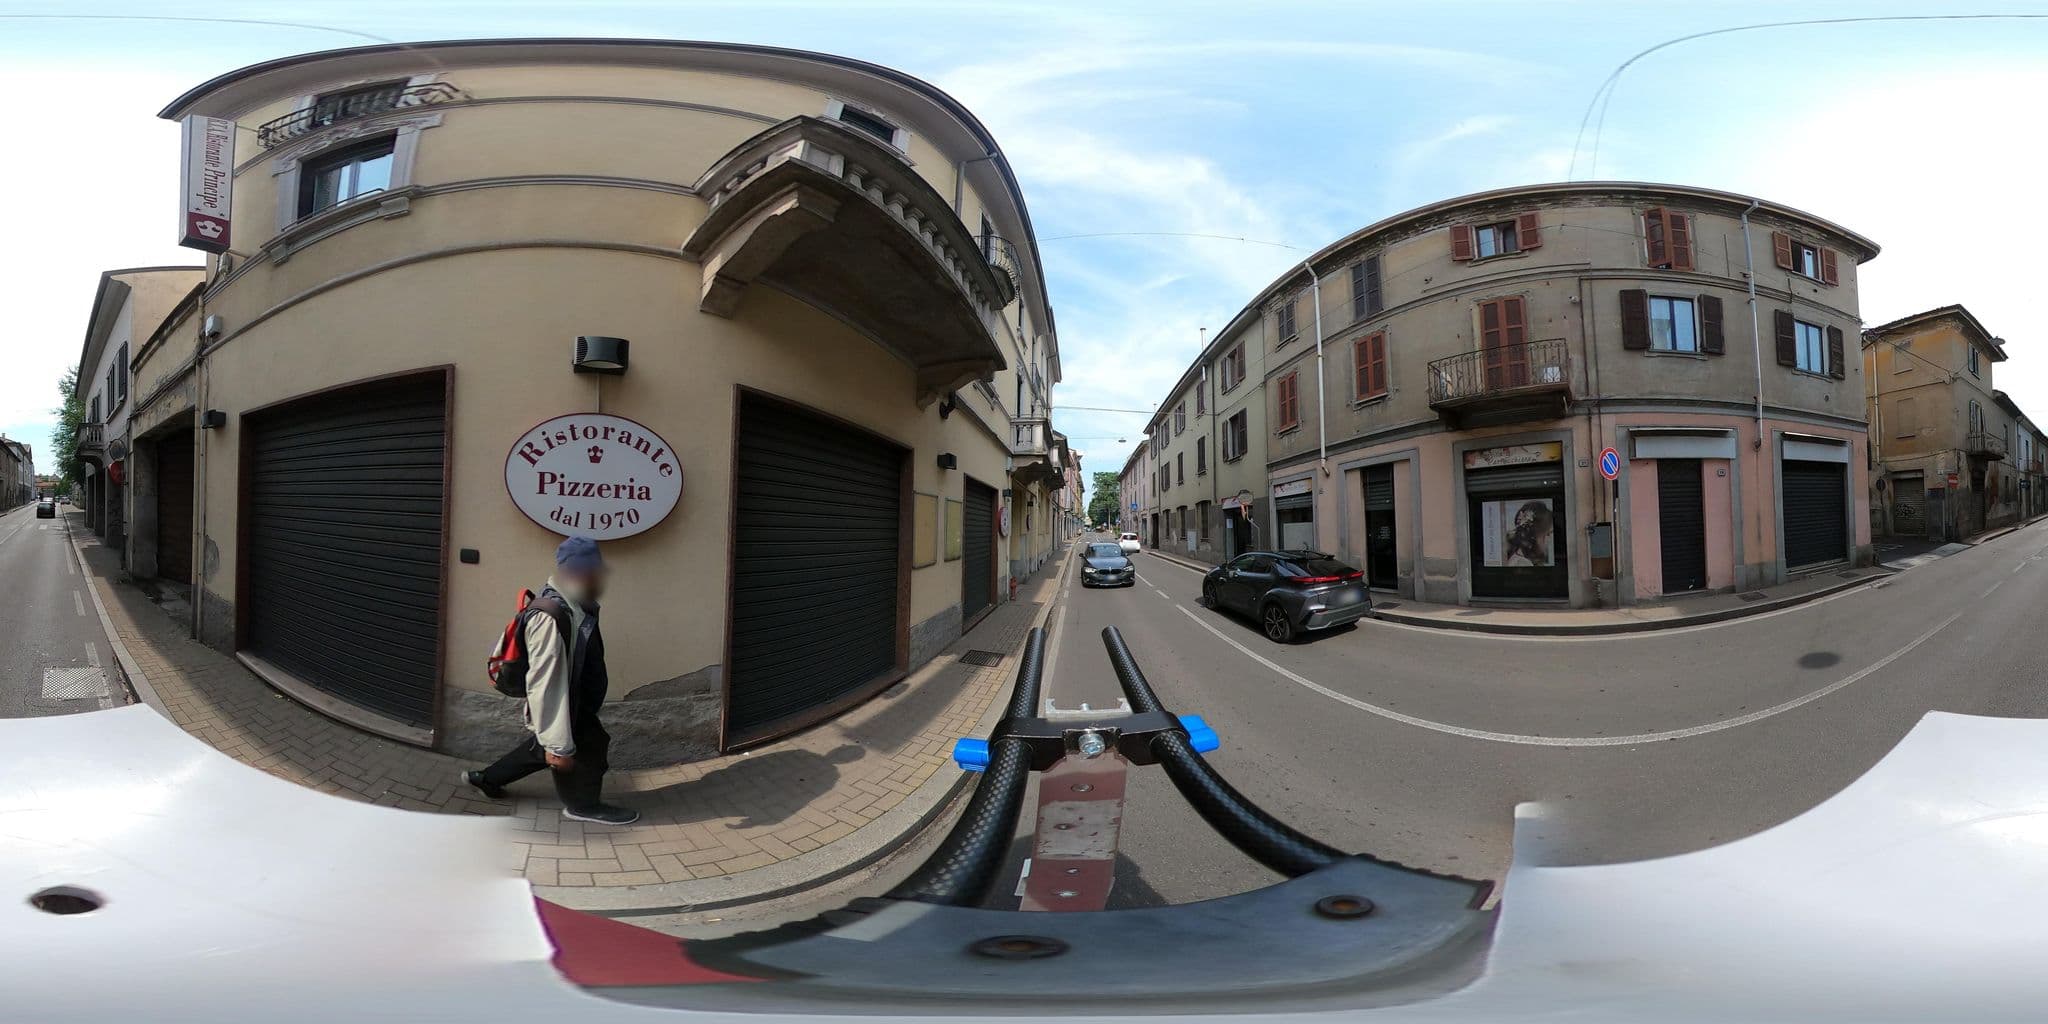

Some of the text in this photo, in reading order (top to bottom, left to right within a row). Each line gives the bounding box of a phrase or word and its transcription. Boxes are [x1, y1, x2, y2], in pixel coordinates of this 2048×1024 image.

[205, 132, 228, 168] Ristorante
[196, 169, 226, 209] Principe
[516, 423, 674, 478] Ristorante
[536, 471, 652, 501] Pizzeria
[550, 506, 640, 531] dal 1970
